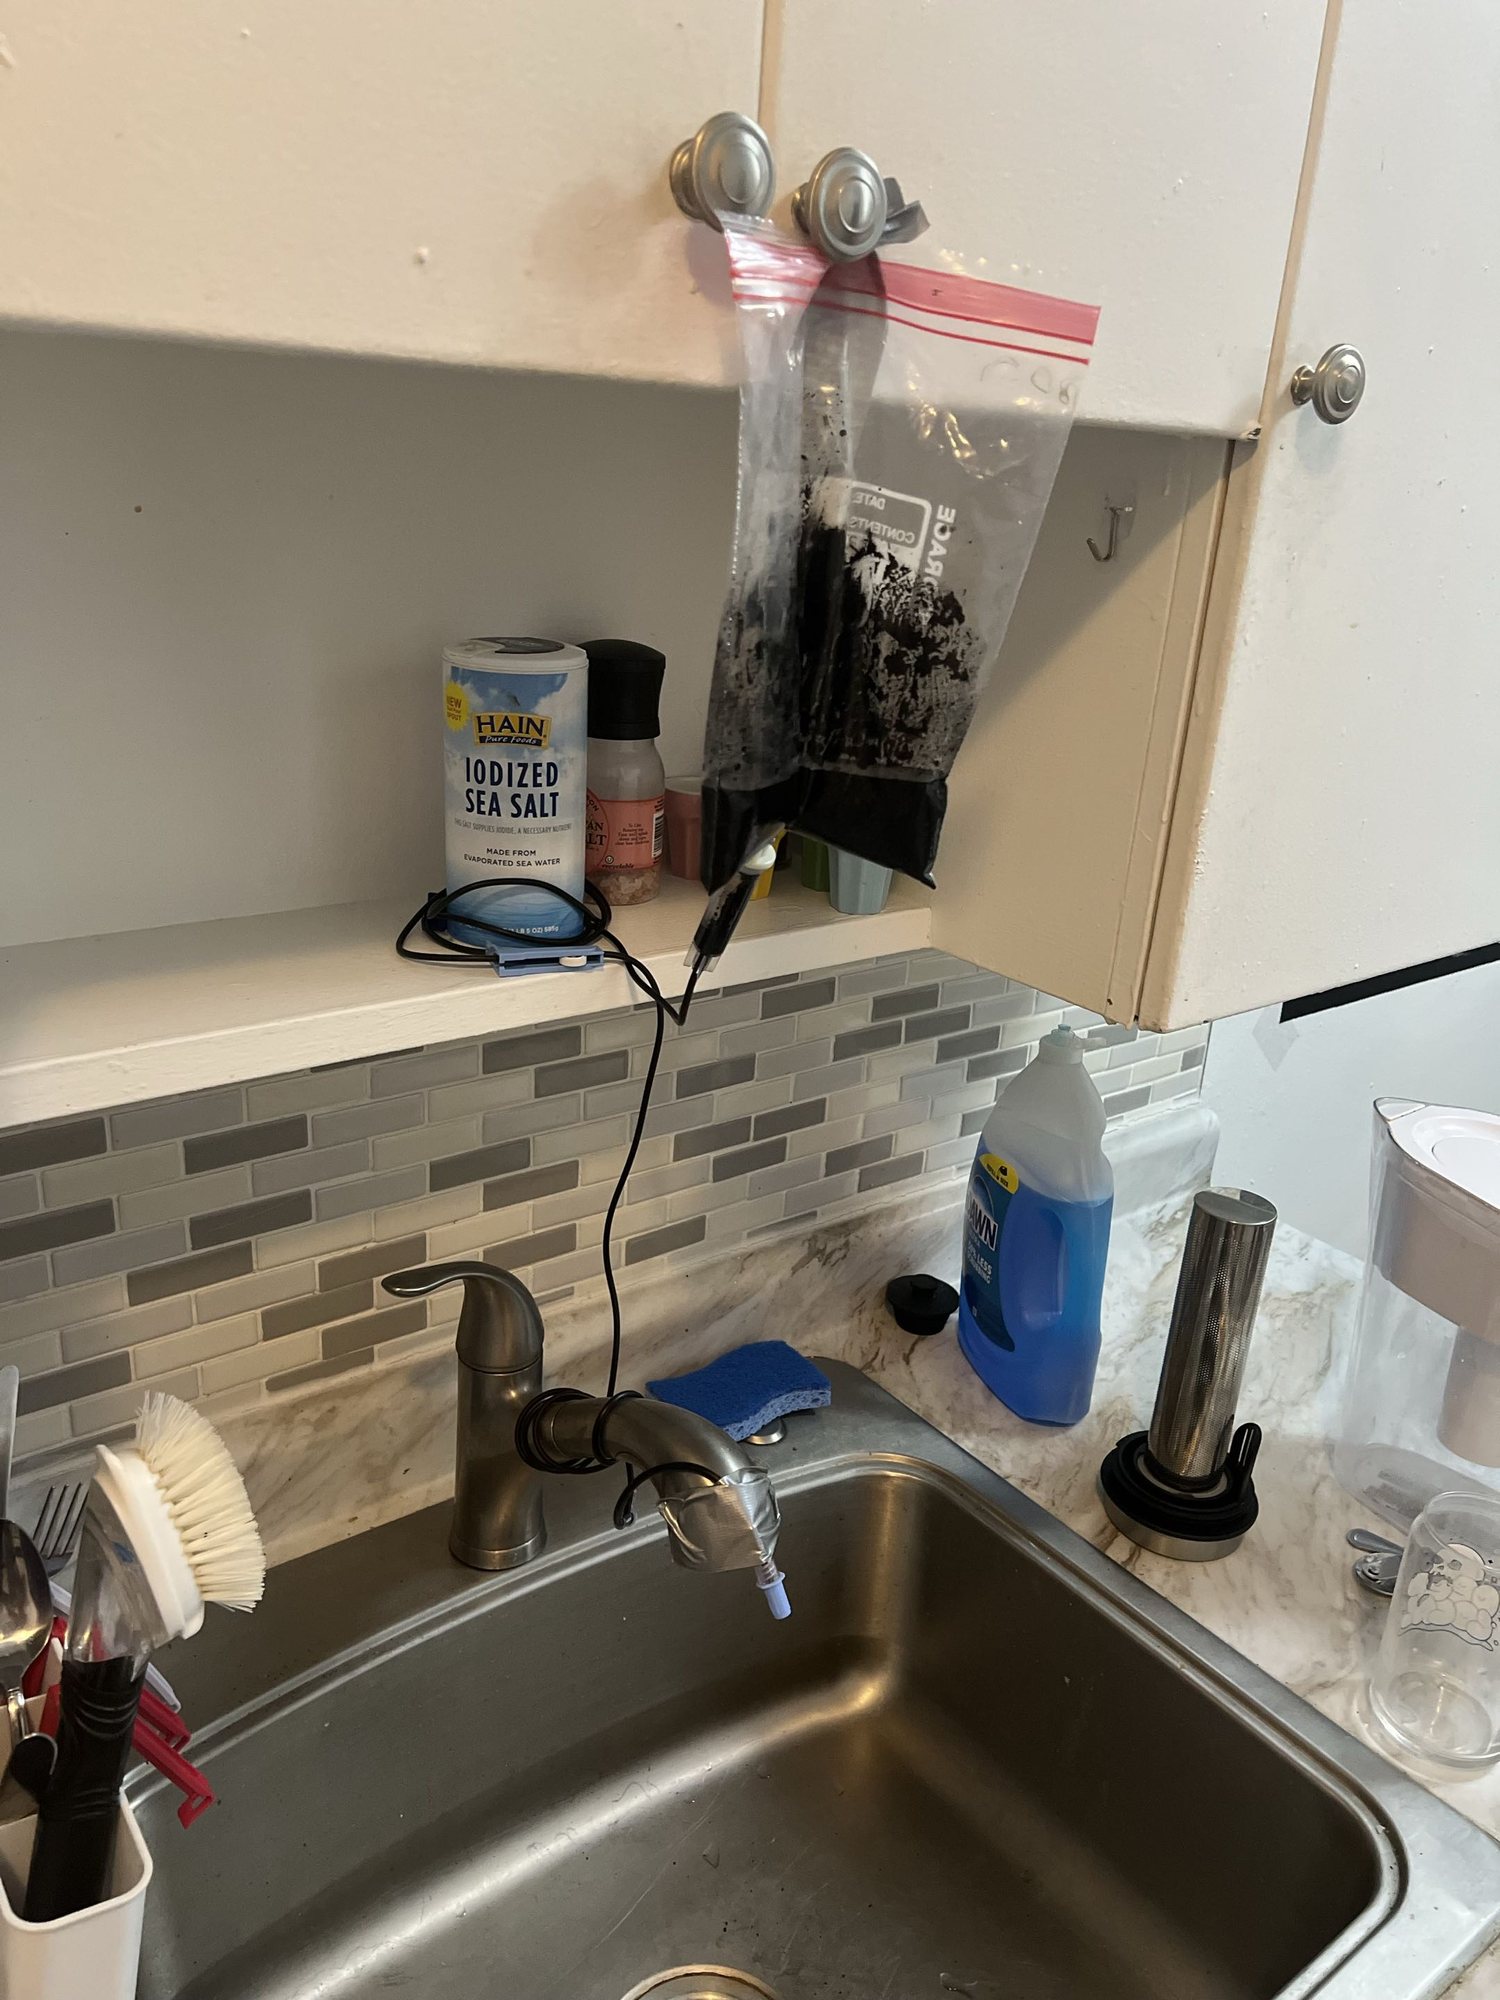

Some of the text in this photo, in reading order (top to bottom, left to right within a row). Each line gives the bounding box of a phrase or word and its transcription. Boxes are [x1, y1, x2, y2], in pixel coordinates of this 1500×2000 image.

[477, 715, 546, 737] HAIN
[485, 736, 537, 745] Pure Foods
[466, 757, 558, 788] IODIZED
[465, 788, 502, 817] SEA
[510, 792, 559, 818] SALT
[473, 823, 495, 833] SUPPLIES
[523, 826, 552, 835] NECESSARY
[486, 848, 510, 857] MADE
[464, 854, 514, 867] EVAPORATED
[534, 858, 561, 866] WATER
